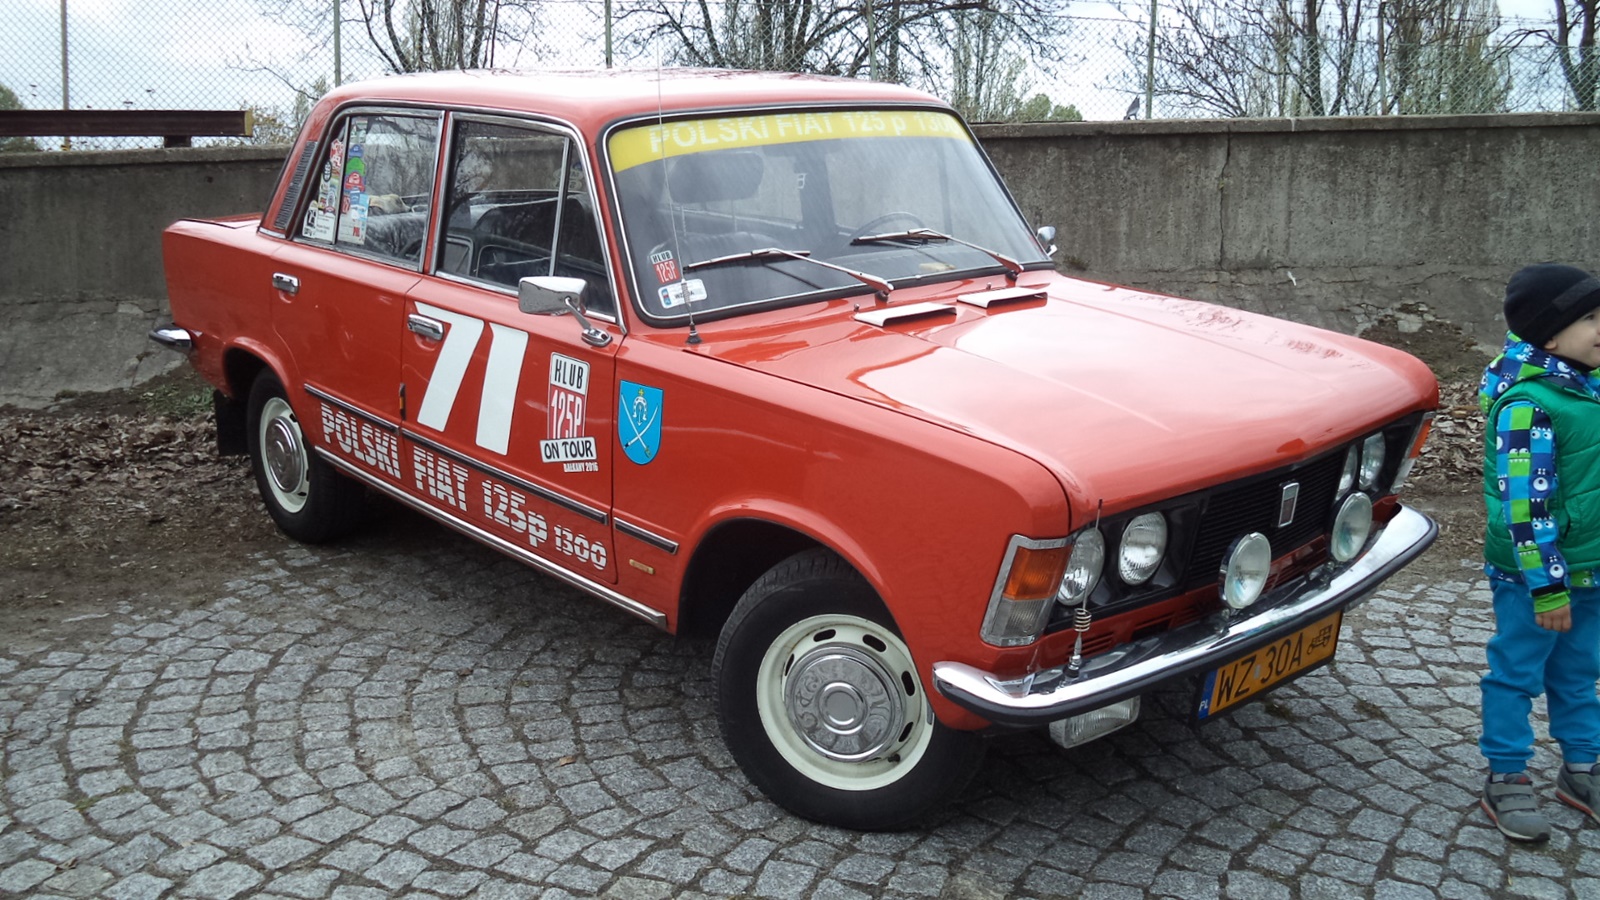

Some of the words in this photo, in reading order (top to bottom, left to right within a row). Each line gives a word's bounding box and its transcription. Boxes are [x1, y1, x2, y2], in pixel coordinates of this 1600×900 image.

[650, 117, 769, 152] POLSKI
[776, 113, 833, 137] FIAT
[842, 111, 885, 132] 125
[890, 115, 907, 136] p
[656, 260, 677, 283] 125P
[414, 301, 530, 456] 71
[554, 359, 584, 389] KLUB
[551, 389, 582, 440] 125P
[544, 442, 560, 460] ON
[562, 440, 594, 458] TOUR
[321, 402, 401, 479] POLSKI
[413, 445, 469, 512] FIAT
[482, 480, 548, 547] 125p
[553, 524, 607, 570] 1300
[1216, 654, 1257, 707] WZ
[1260, 632, 1303, 684] 30A
[1199, 699, 1208, 711] PL
